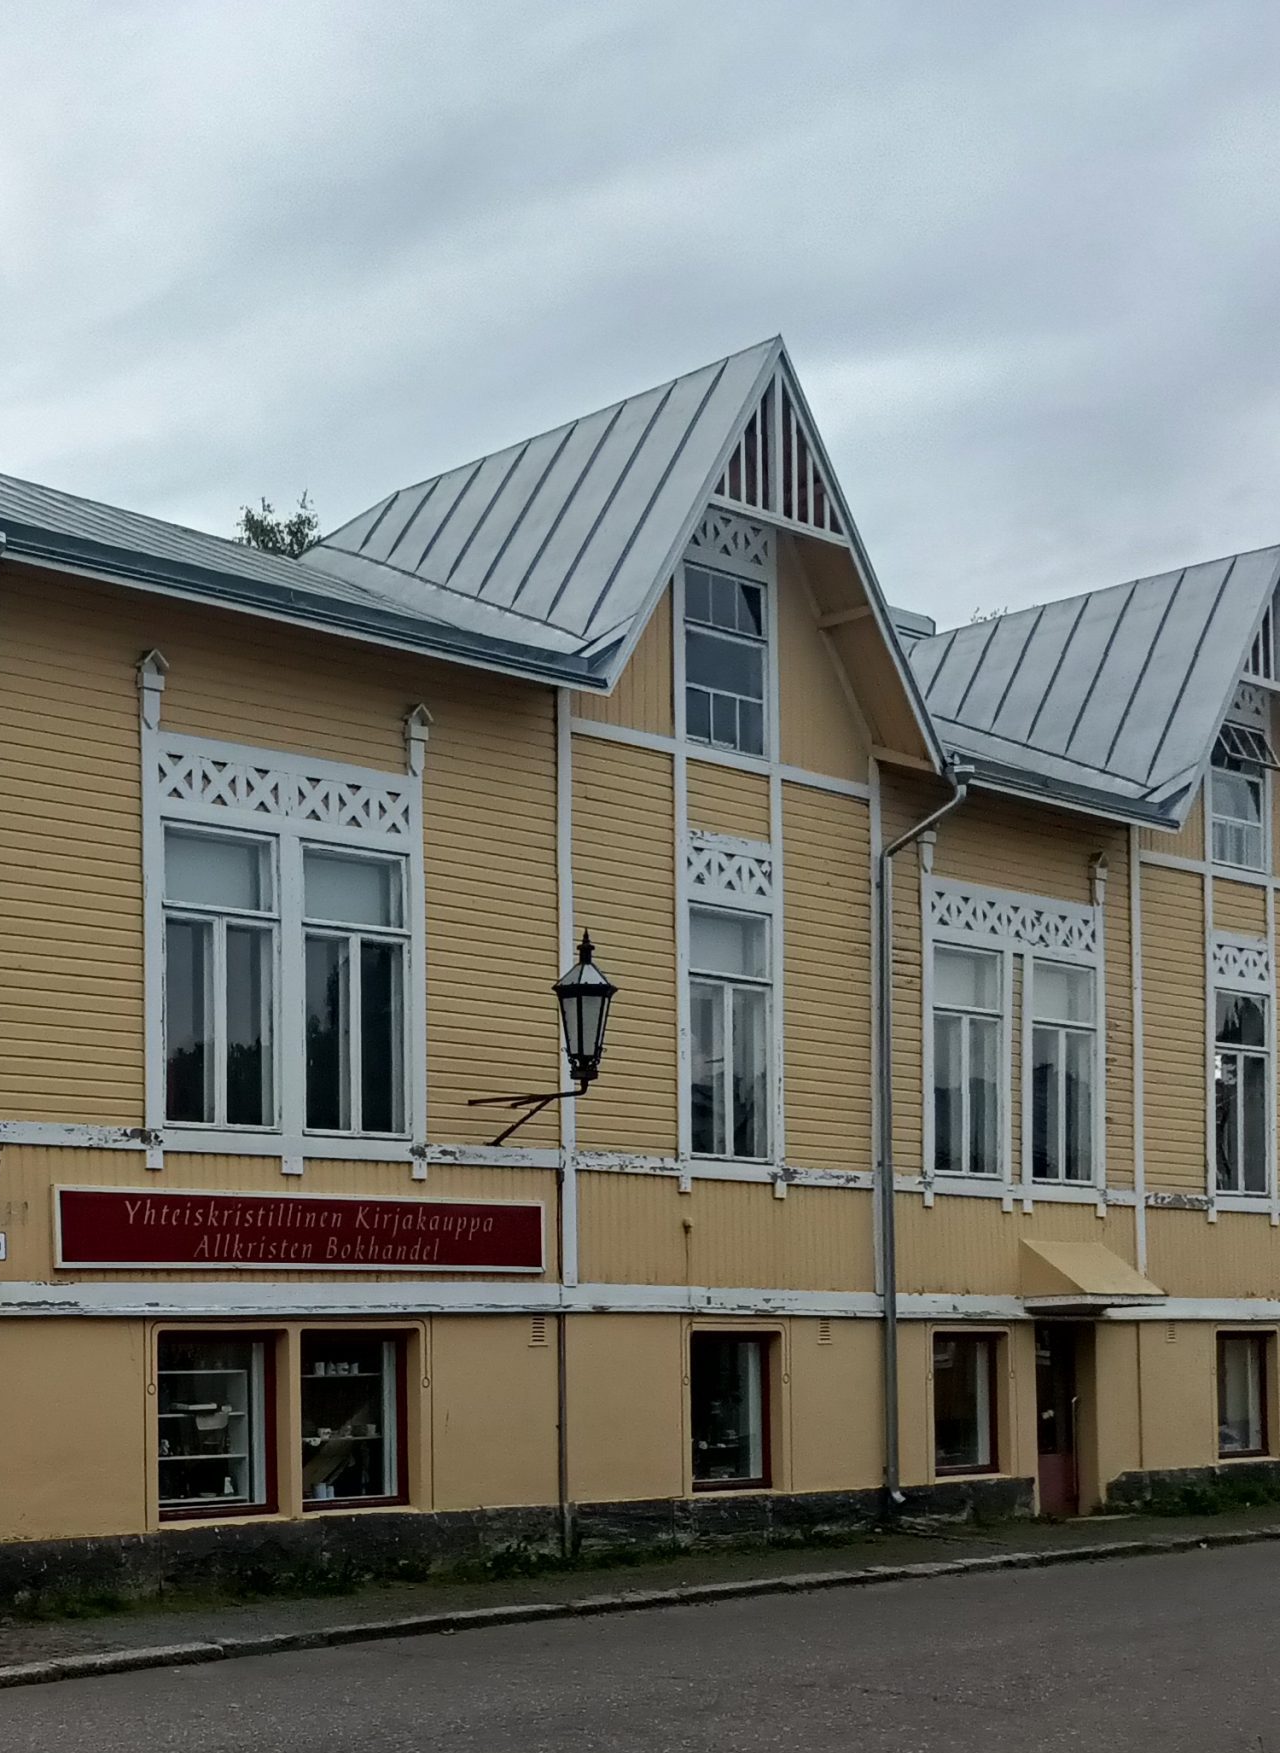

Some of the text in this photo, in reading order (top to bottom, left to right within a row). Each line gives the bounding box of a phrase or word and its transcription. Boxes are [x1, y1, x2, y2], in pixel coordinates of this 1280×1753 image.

[125, 1200, 494, 1241] Yhteiskristillinen Kirjakauppa
[193, 1234, 440, 1262] Allkristen Bokhandel
